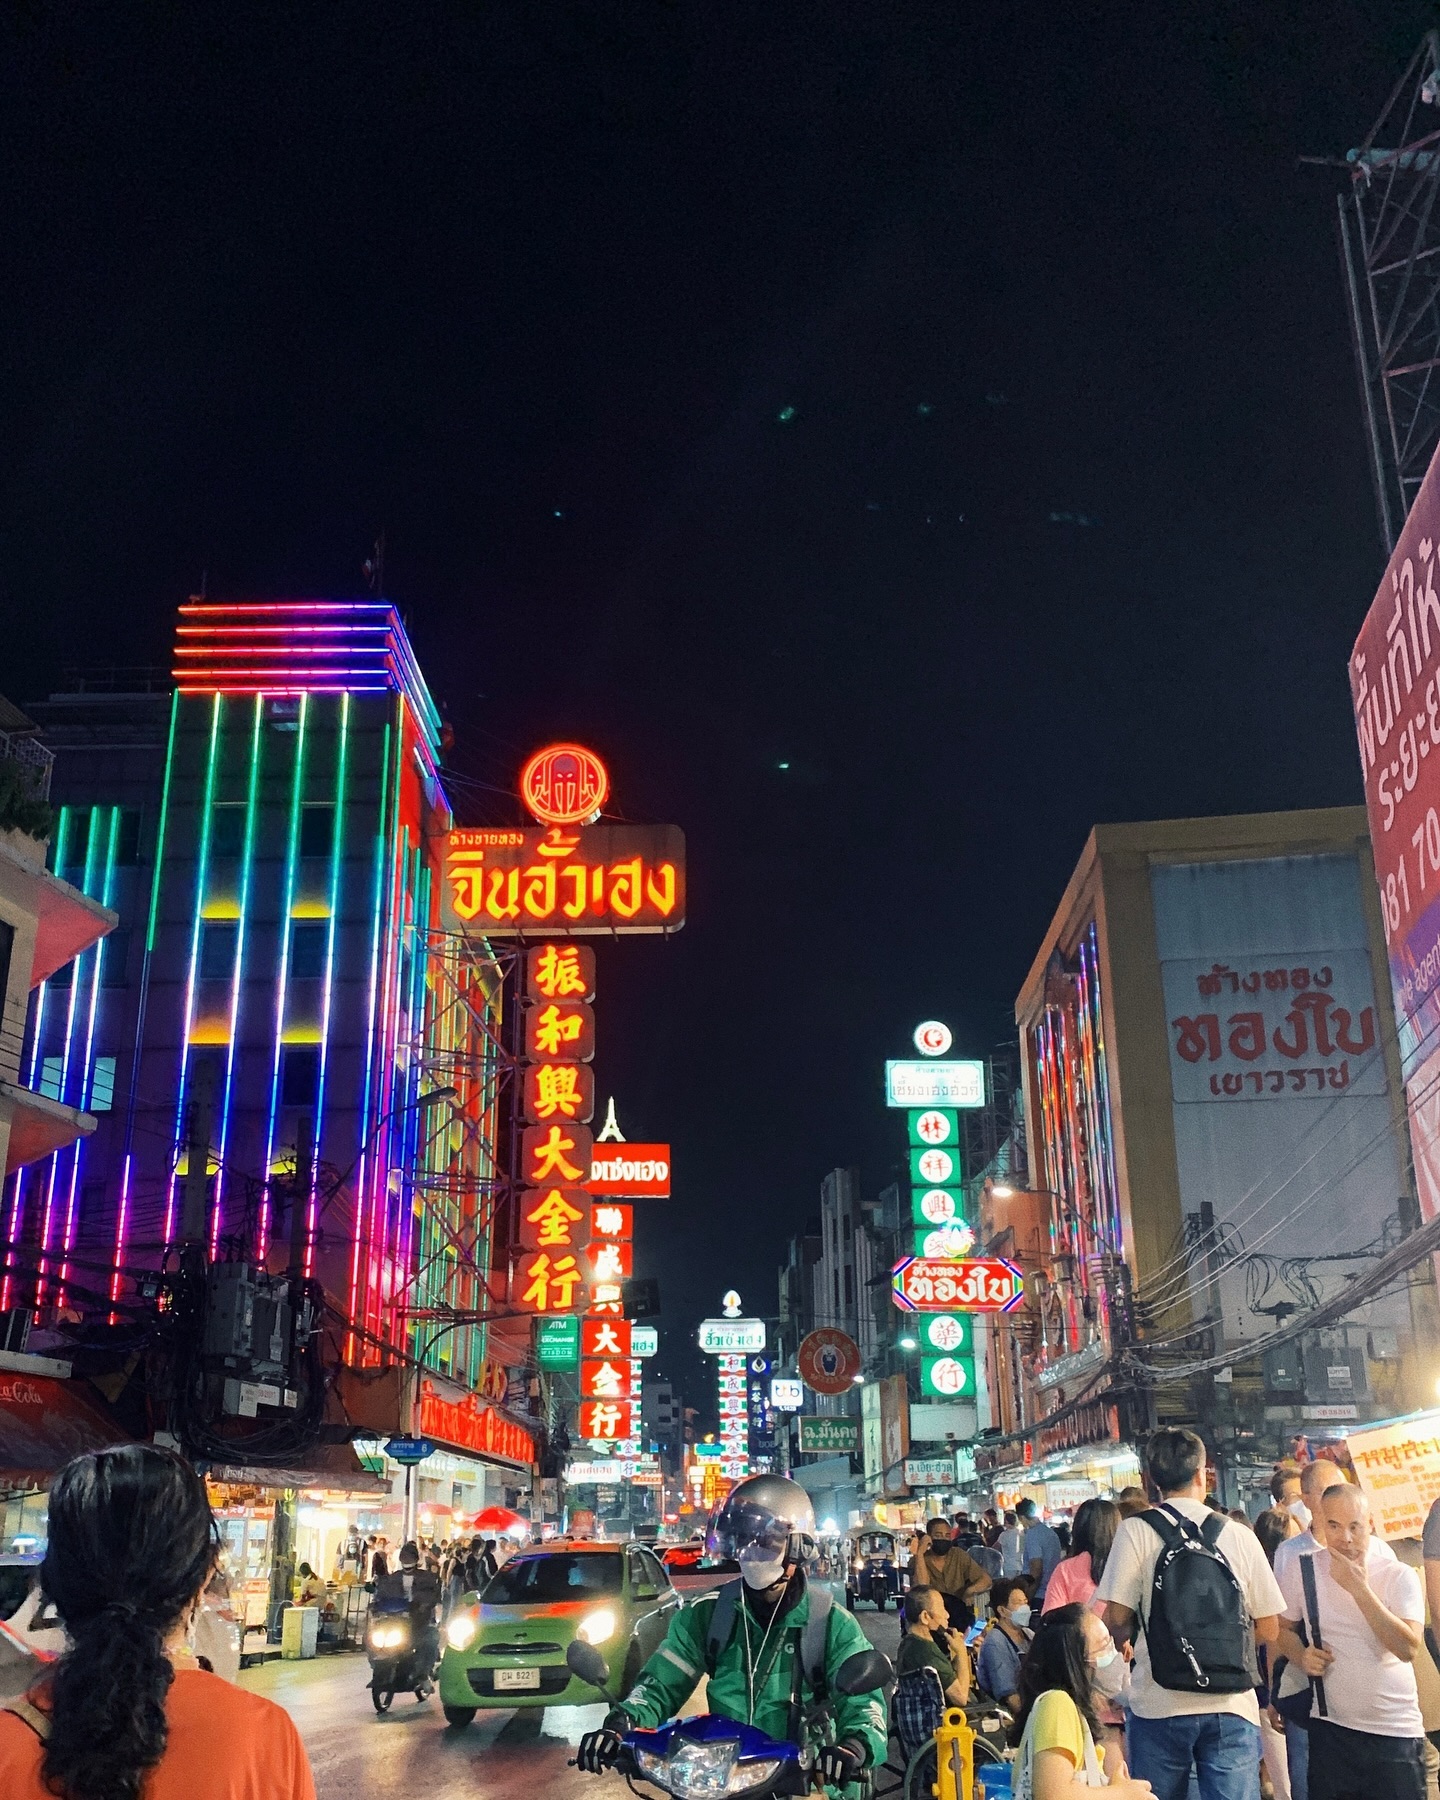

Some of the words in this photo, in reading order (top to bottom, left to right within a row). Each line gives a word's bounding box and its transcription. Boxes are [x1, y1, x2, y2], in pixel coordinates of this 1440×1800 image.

[1355, 537, 1440, 783] พื้นที่ให้
[449, 830, 524, 846] ห้างขายทอง
[446, 828, 676, 921] จินฮั้วเฮง
[1196, 963, 1333, 996] ห้างทอง
[1171, 991, 1376, 1064] ทองใบ
[1209, 1059, 1350, 1096] เยาวราช
[523, 944, 587, 1311] 振和興大金行
[906, 1265, 1012, 1303] ทองใบ
[911, 1261, 964, 1278] ห้างทอง
[548, 1320, 567, 1329] ATM
[421, 1443, 428, 1453] 6
